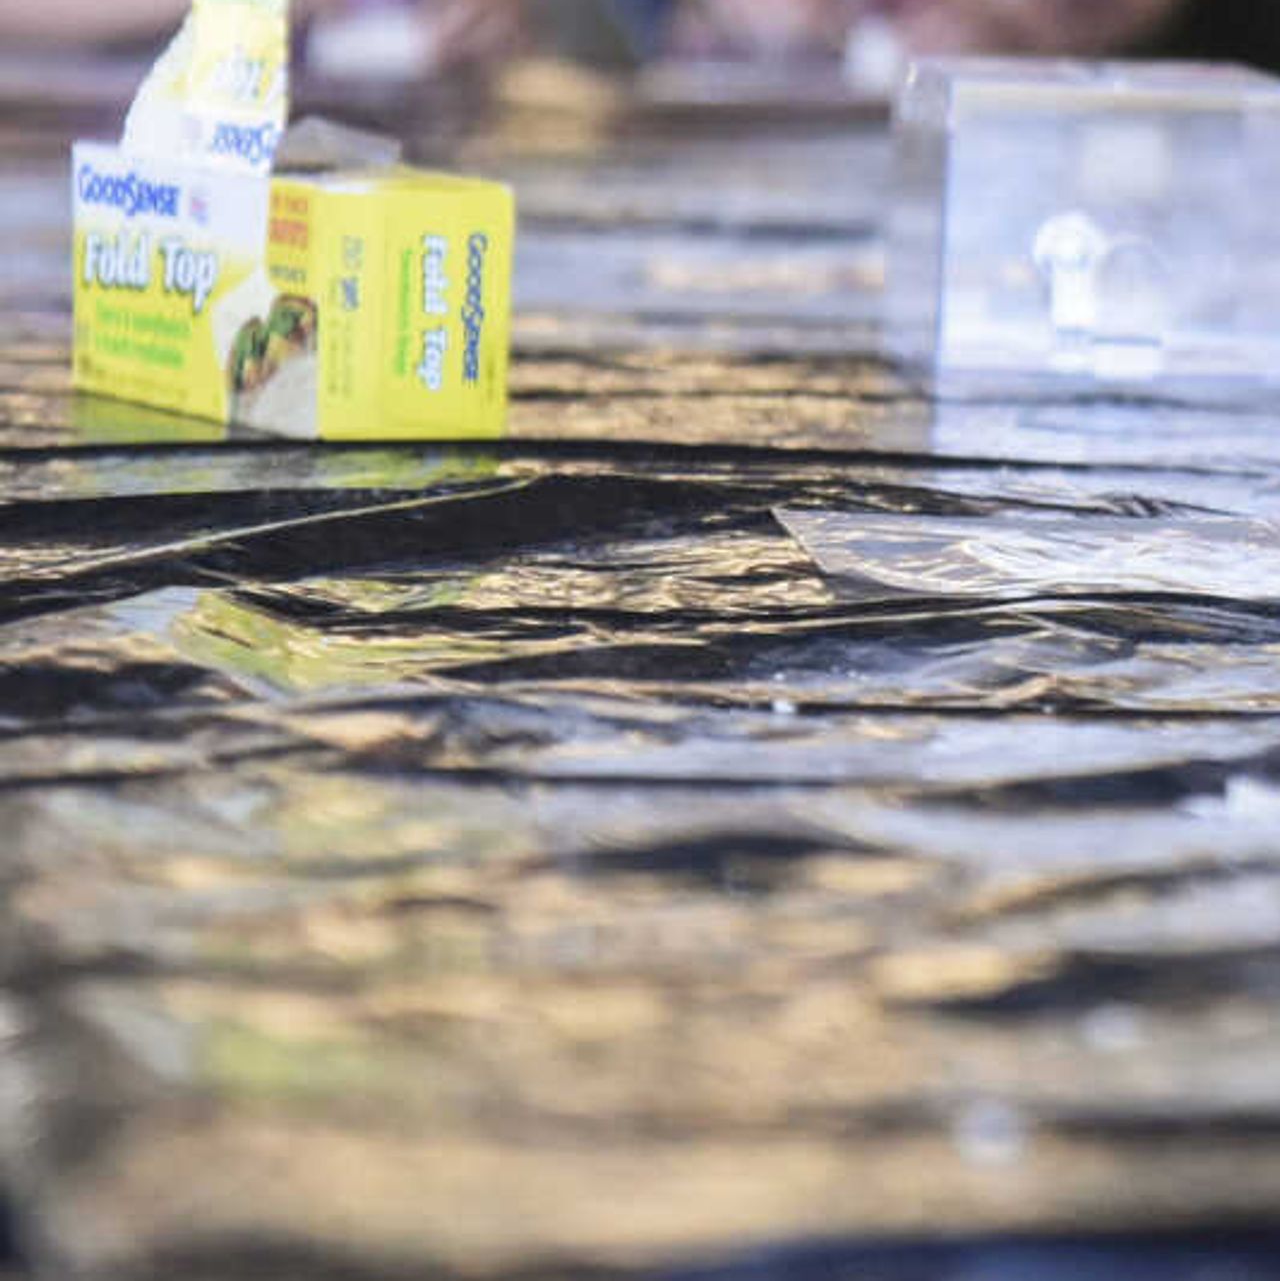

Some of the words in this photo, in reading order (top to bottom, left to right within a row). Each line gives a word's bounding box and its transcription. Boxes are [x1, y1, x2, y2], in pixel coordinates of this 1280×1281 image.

[83, 232, 149, 290] Fold
[158, 238, 216, 315] Top
[423, 233, 449, 314] Fold
[416, 324, 448, 391] Top
